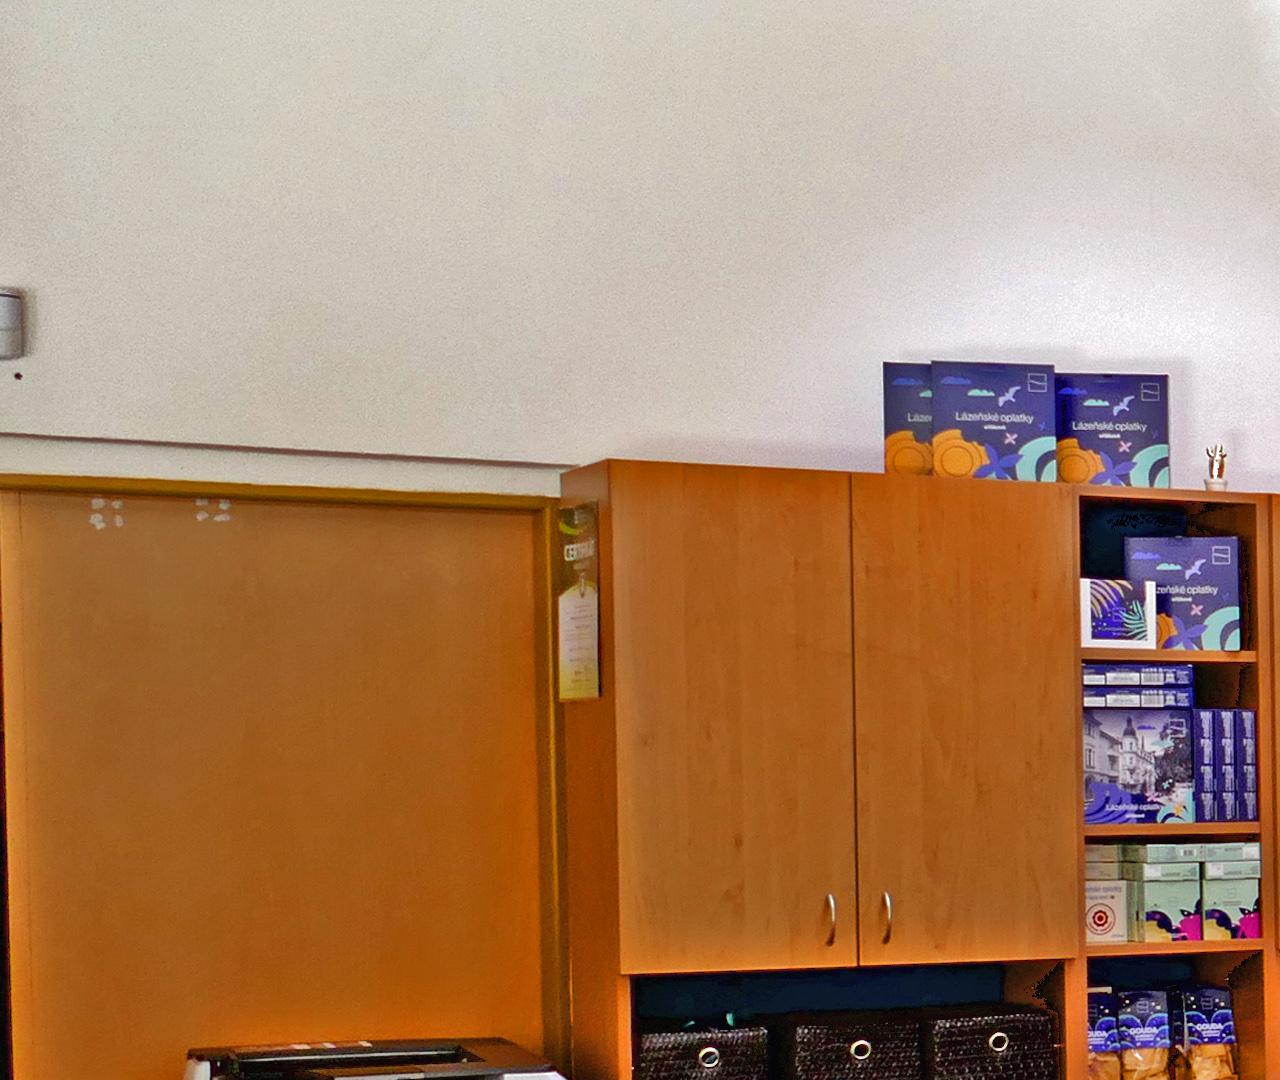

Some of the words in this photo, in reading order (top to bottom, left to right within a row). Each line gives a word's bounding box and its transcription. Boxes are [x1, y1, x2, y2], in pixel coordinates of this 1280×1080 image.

[907, 412, 932, 422] Láze
[955, 411, 998, 422] Lázeňské
[1001, 412, 1034, 425] oplatky
[1072, 421, 1113, 431] Lázeňské
[1114, 422, 1148, 432] oplatky
[1187, 586, 1218, 596] oplatky
